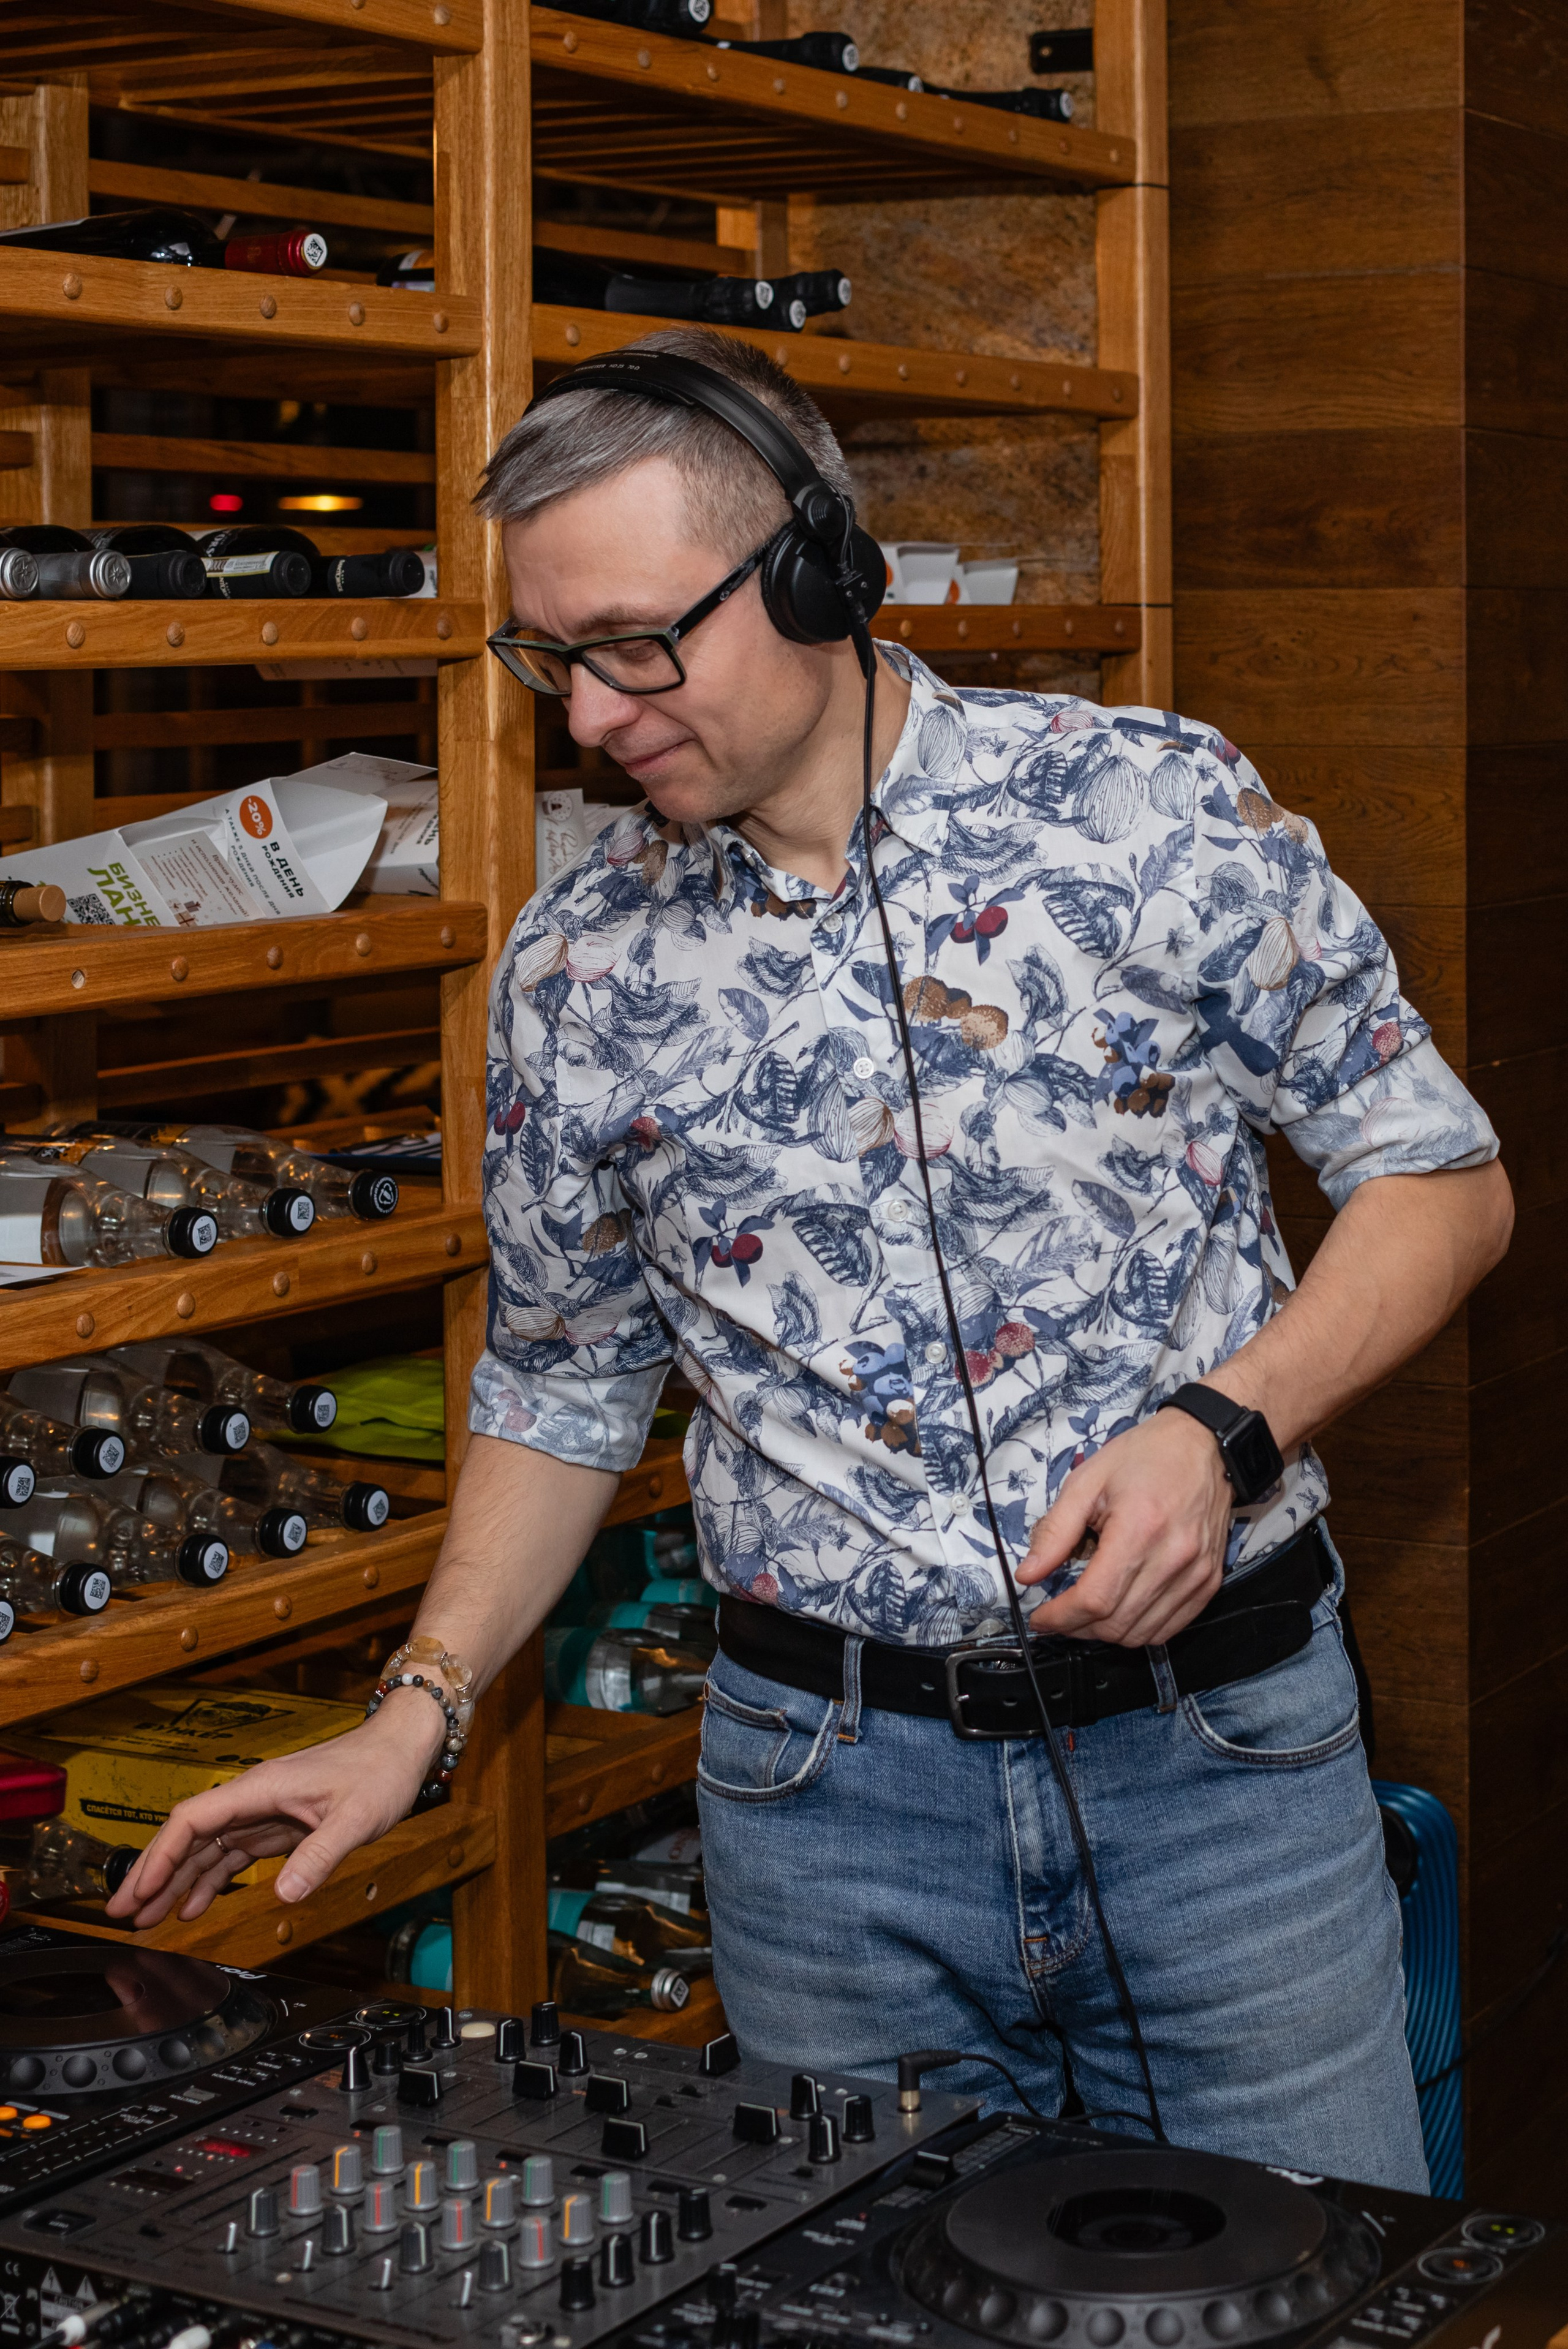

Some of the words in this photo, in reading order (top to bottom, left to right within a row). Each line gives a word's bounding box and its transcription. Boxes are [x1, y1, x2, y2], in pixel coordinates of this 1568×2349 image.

[247, 798, 266, 836] -20%
[213, 854, 230, 876] Время
[229, 877, 244, 895] чудес
[227, 816, 240, 843] ТАКЖЕ
[241, 852, 254, 873] ДНЕЙ
[253, 874, 270, 899] ПОСЛЕ
[268, 901, 281, 915] ДНЯ
[231, 845, 254, 888] РОЖДЕНИЯ
[262, 845, 295, 899] РОЖДЕНИЯ
[270, 842, 280, 852] В
[276, 858, 304, 897] ДЕНЬ
[86, 1804, 122, 1815] СПАСЁТСЯ
